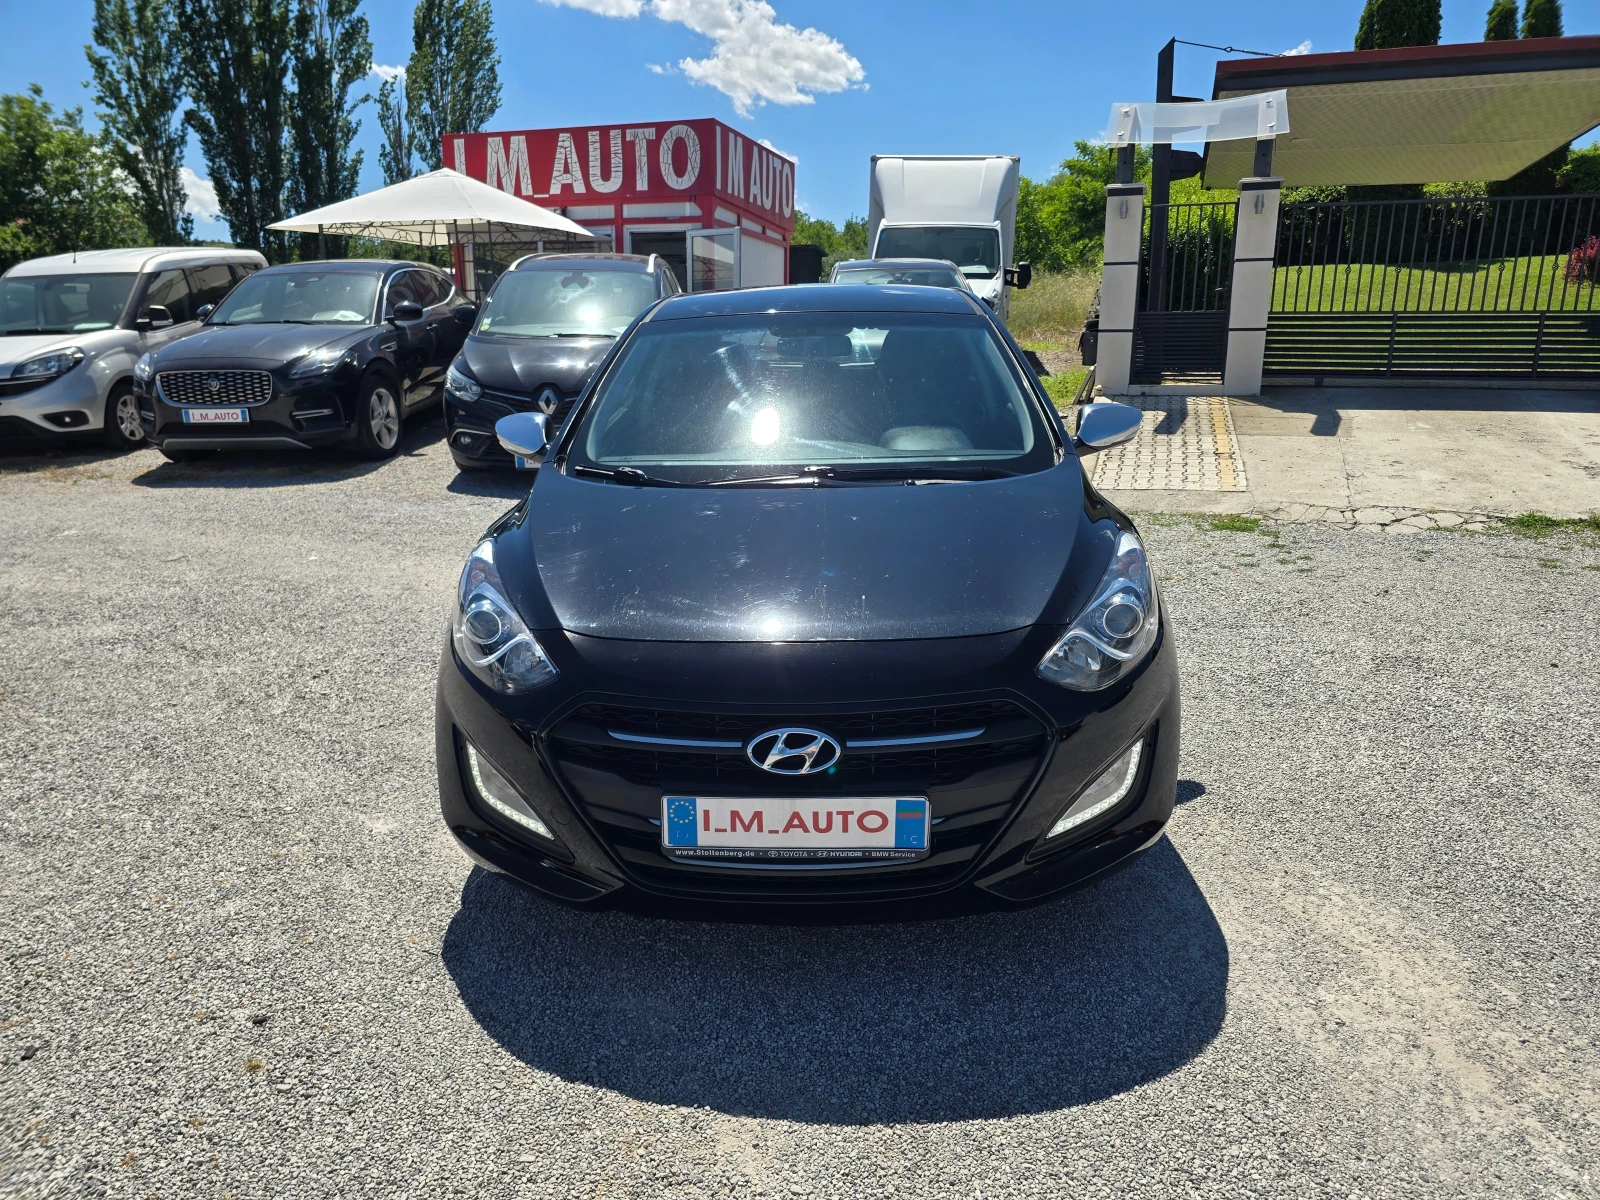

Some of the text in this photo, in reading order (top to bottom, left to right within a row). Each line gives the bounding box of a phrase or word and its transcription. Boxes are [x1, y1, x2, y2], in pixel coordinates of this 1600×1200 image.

[749, 145, 793, 219] AUTO
[702, 809, 889, 834] I_M_AUTO
[675, 849, 755, 857] www.Stoltenberg.de
